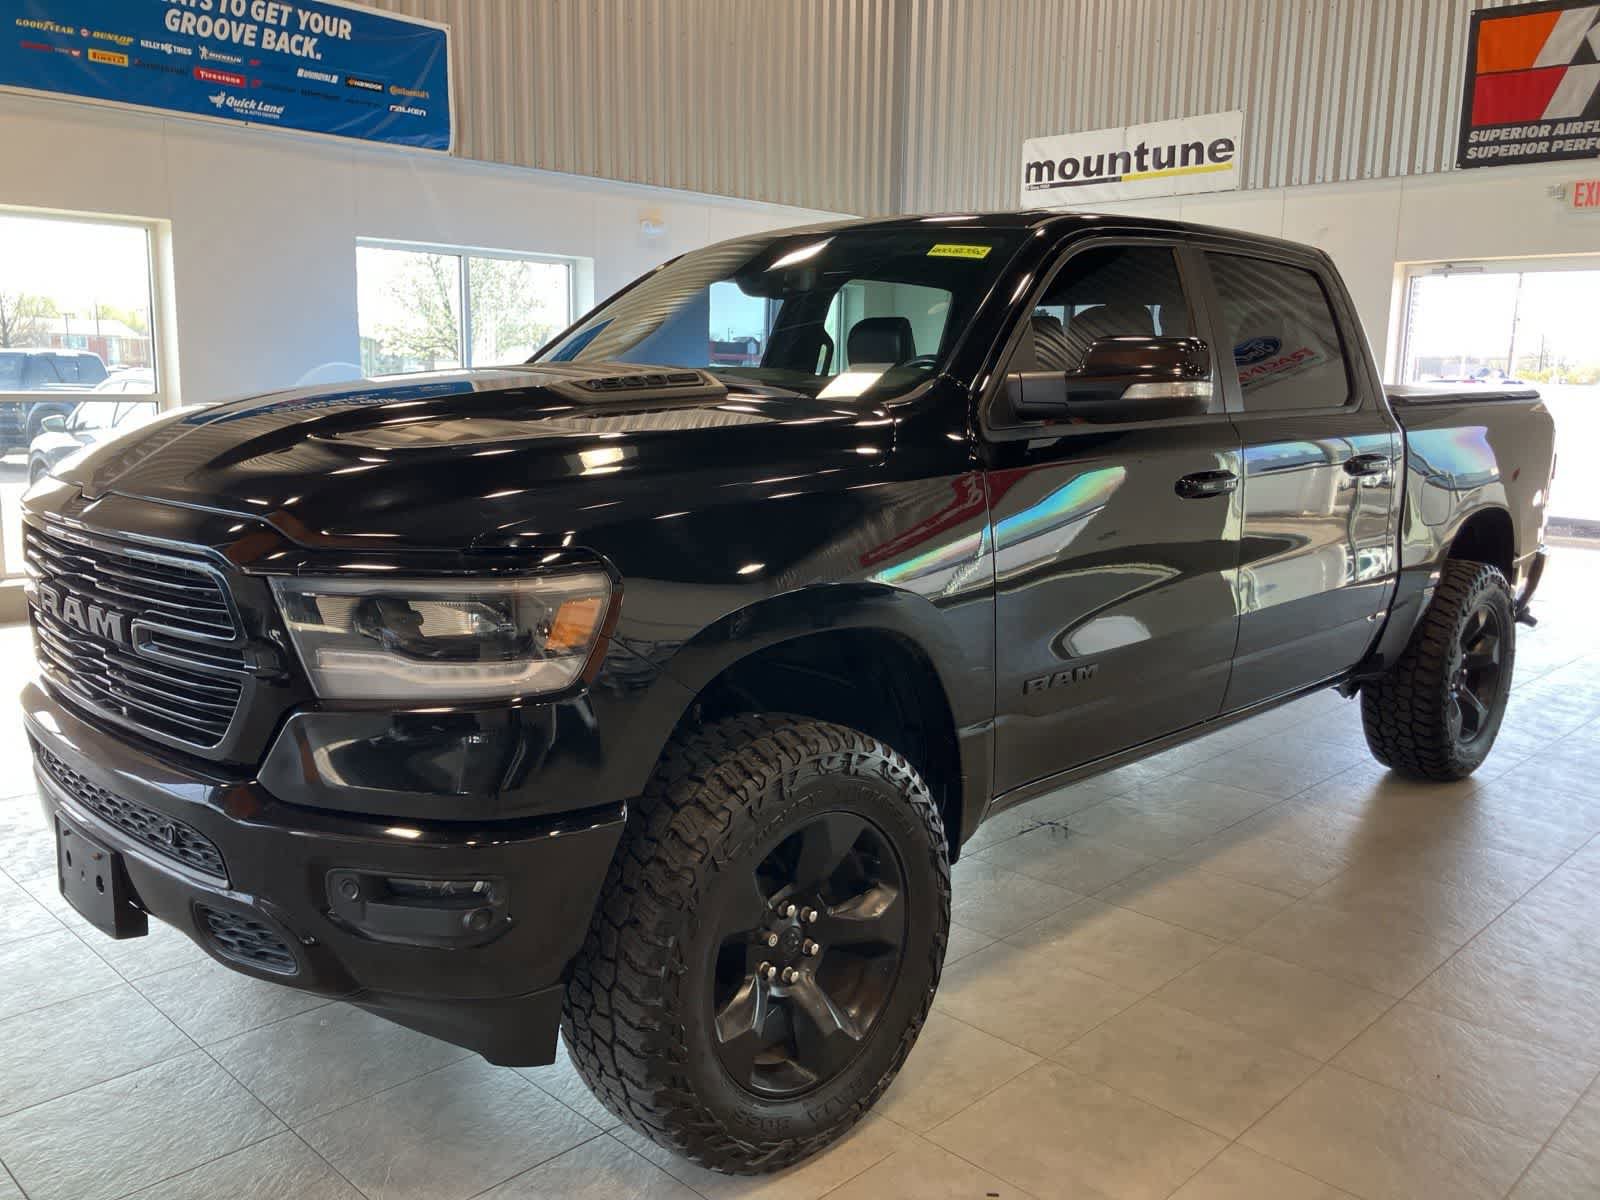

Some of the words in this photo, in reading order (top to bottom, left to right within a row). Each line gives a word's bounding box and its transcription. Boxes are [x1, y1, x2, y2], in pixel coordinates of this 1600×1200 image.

[164, 8, 258, 47] GROOVE
[261, 28, 322, 60] BACK.
[251, 0, 292, 26] GET
[297, 9, 352, 40] YOUR
[92, 31, 134, 46] DUNLOP
[226, 95, 257, 110] Quick
[257, 101, 285, 115] Lane
[1468, 124, 1551, 143] SUPERIOR
[1025, 137, 1235, 183] mountune
[1466, 141, 1550, 159] SUPERIOR
[39, 582, 125, 643] RAM
[1022, 664, 1099, 696] RAM
